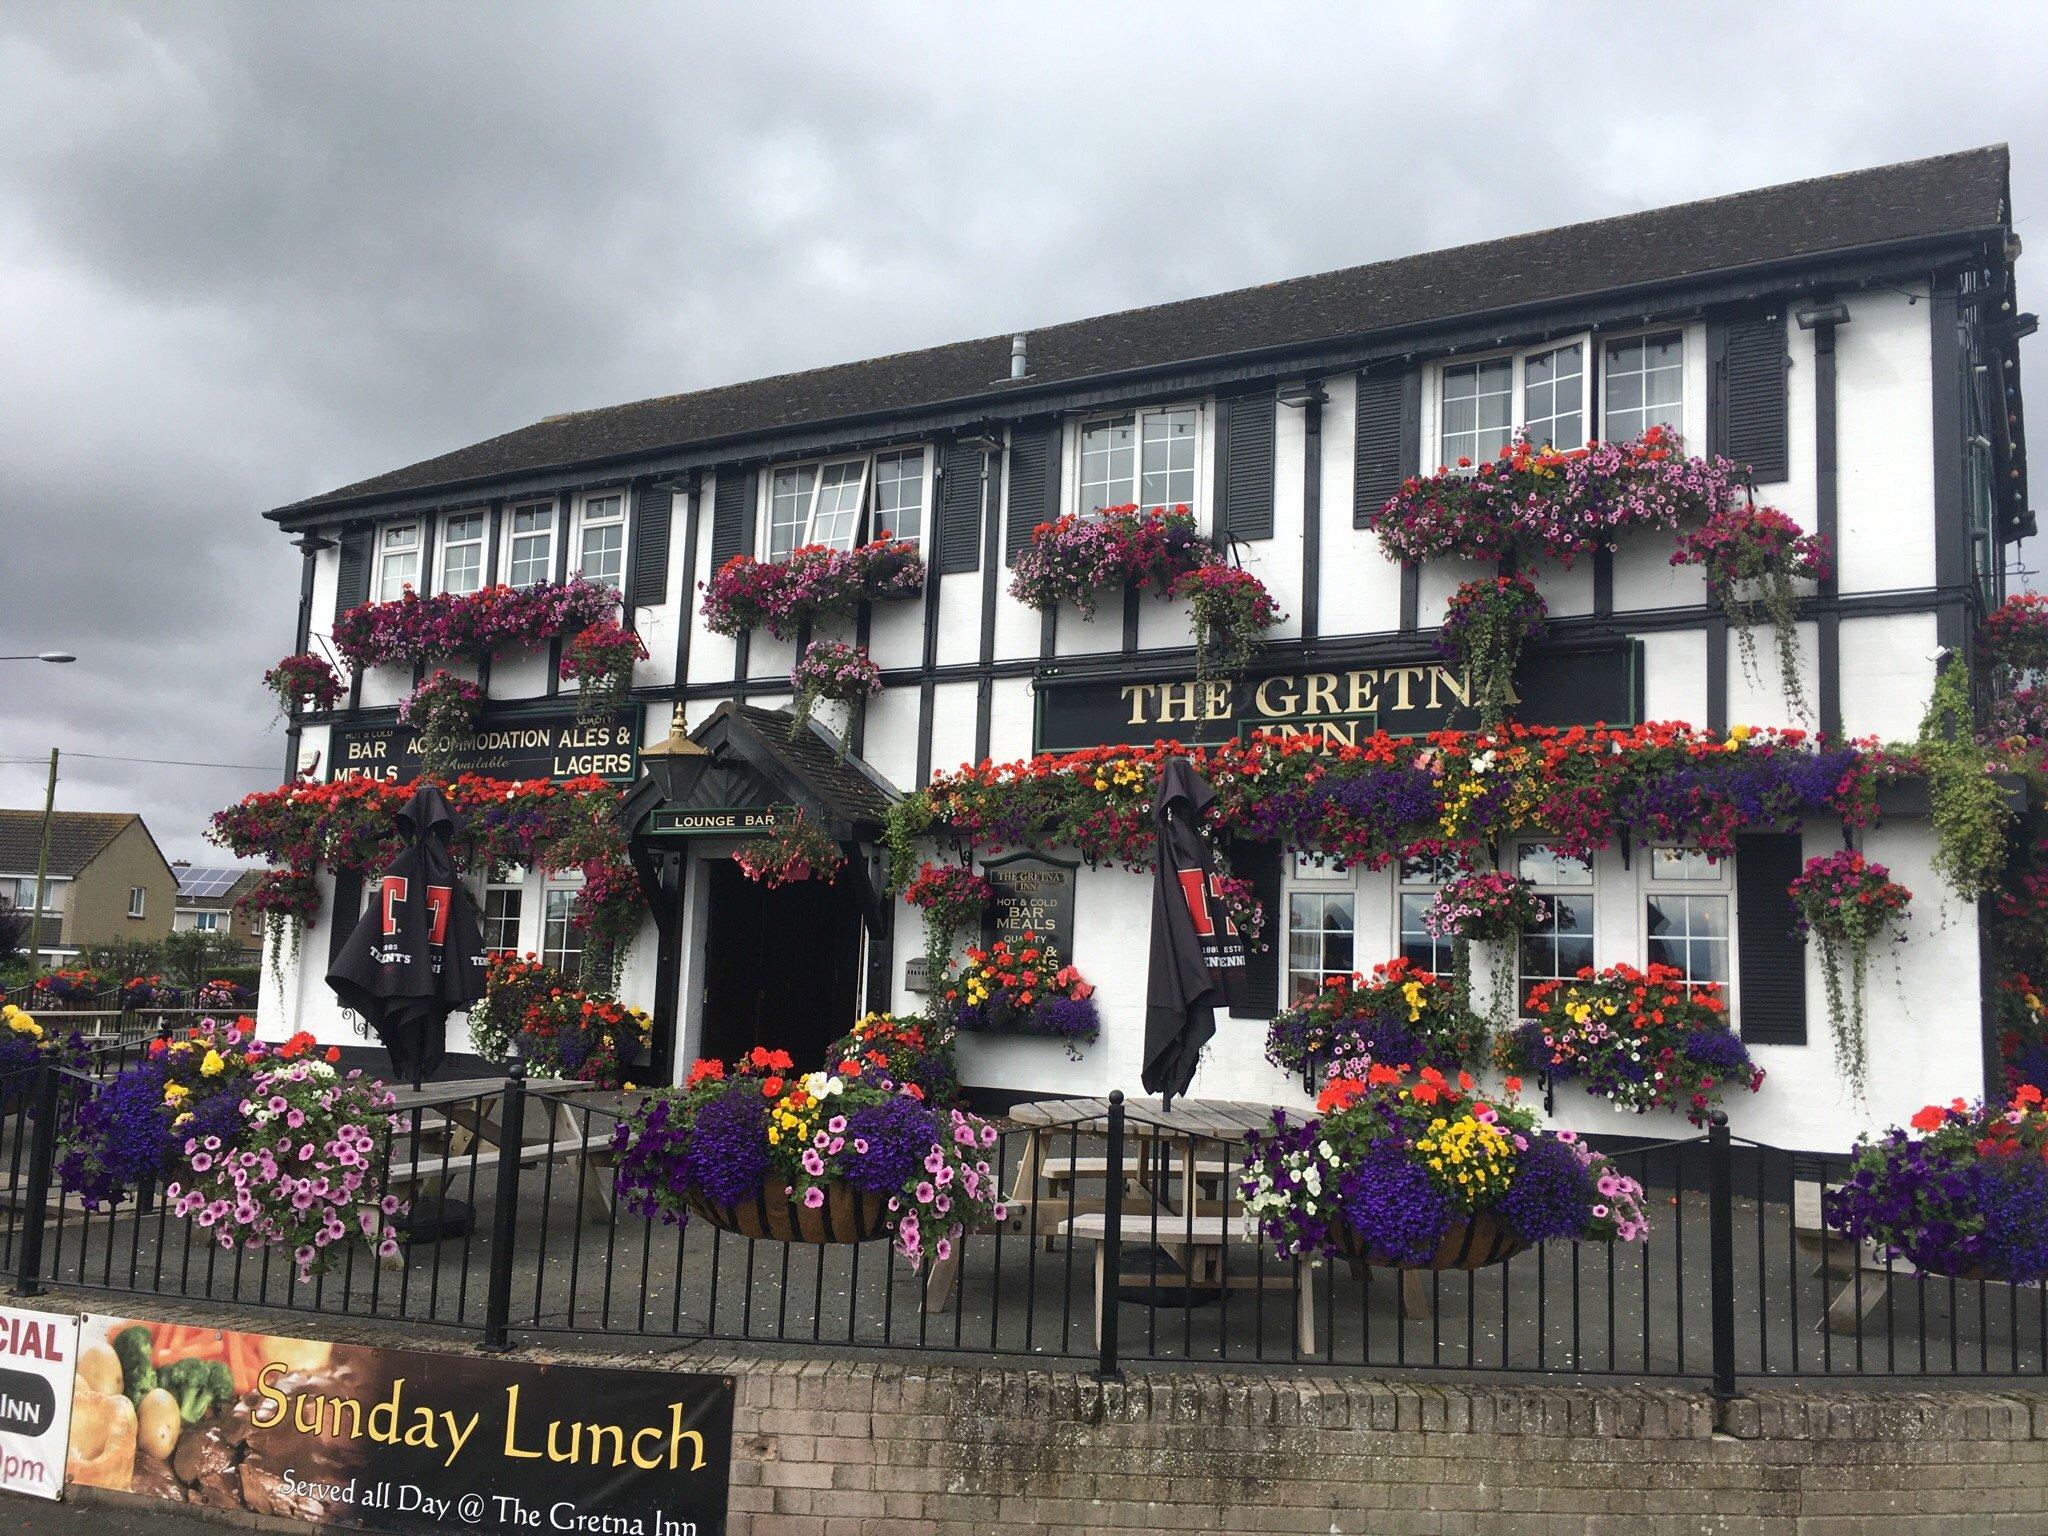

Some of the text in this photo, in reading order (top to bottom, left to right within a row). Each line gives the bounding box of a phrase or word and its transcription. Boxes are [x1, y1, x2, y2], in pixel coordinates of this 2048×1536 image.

[1121, 665, 1522, 725] THE GRETNA
[406, 729, 551, 754] ACOMODATION
[558, 726, 631, 748] ALES &
[348, 741, 387, 760] BAR
[449, 755, 511, 770] Available
[553, 753, 632, 775] LAGERS
[675, 815, 776, 827] LOUNGE BAR
[997, 871, 1060, 881] THE GRETNA
[1020, 882, 1037, 890] INN
[996, 898, 1058, 907] HOT & COLD
[1009, 907, 1044, 918] BAR
[996, 918, 1056, 930] MEALS
[1004, 935, 1047, 944] QUATY
[1045, 945, 1058, 957] &
[0, 1393, 41, 1425] INN
[250, 1361, 707, 1472] Sunday Lunch
[0, 1446, 45, 1484] pm
[280, 1469, 698, 1536] Served all Day @ The Gretna Inn
